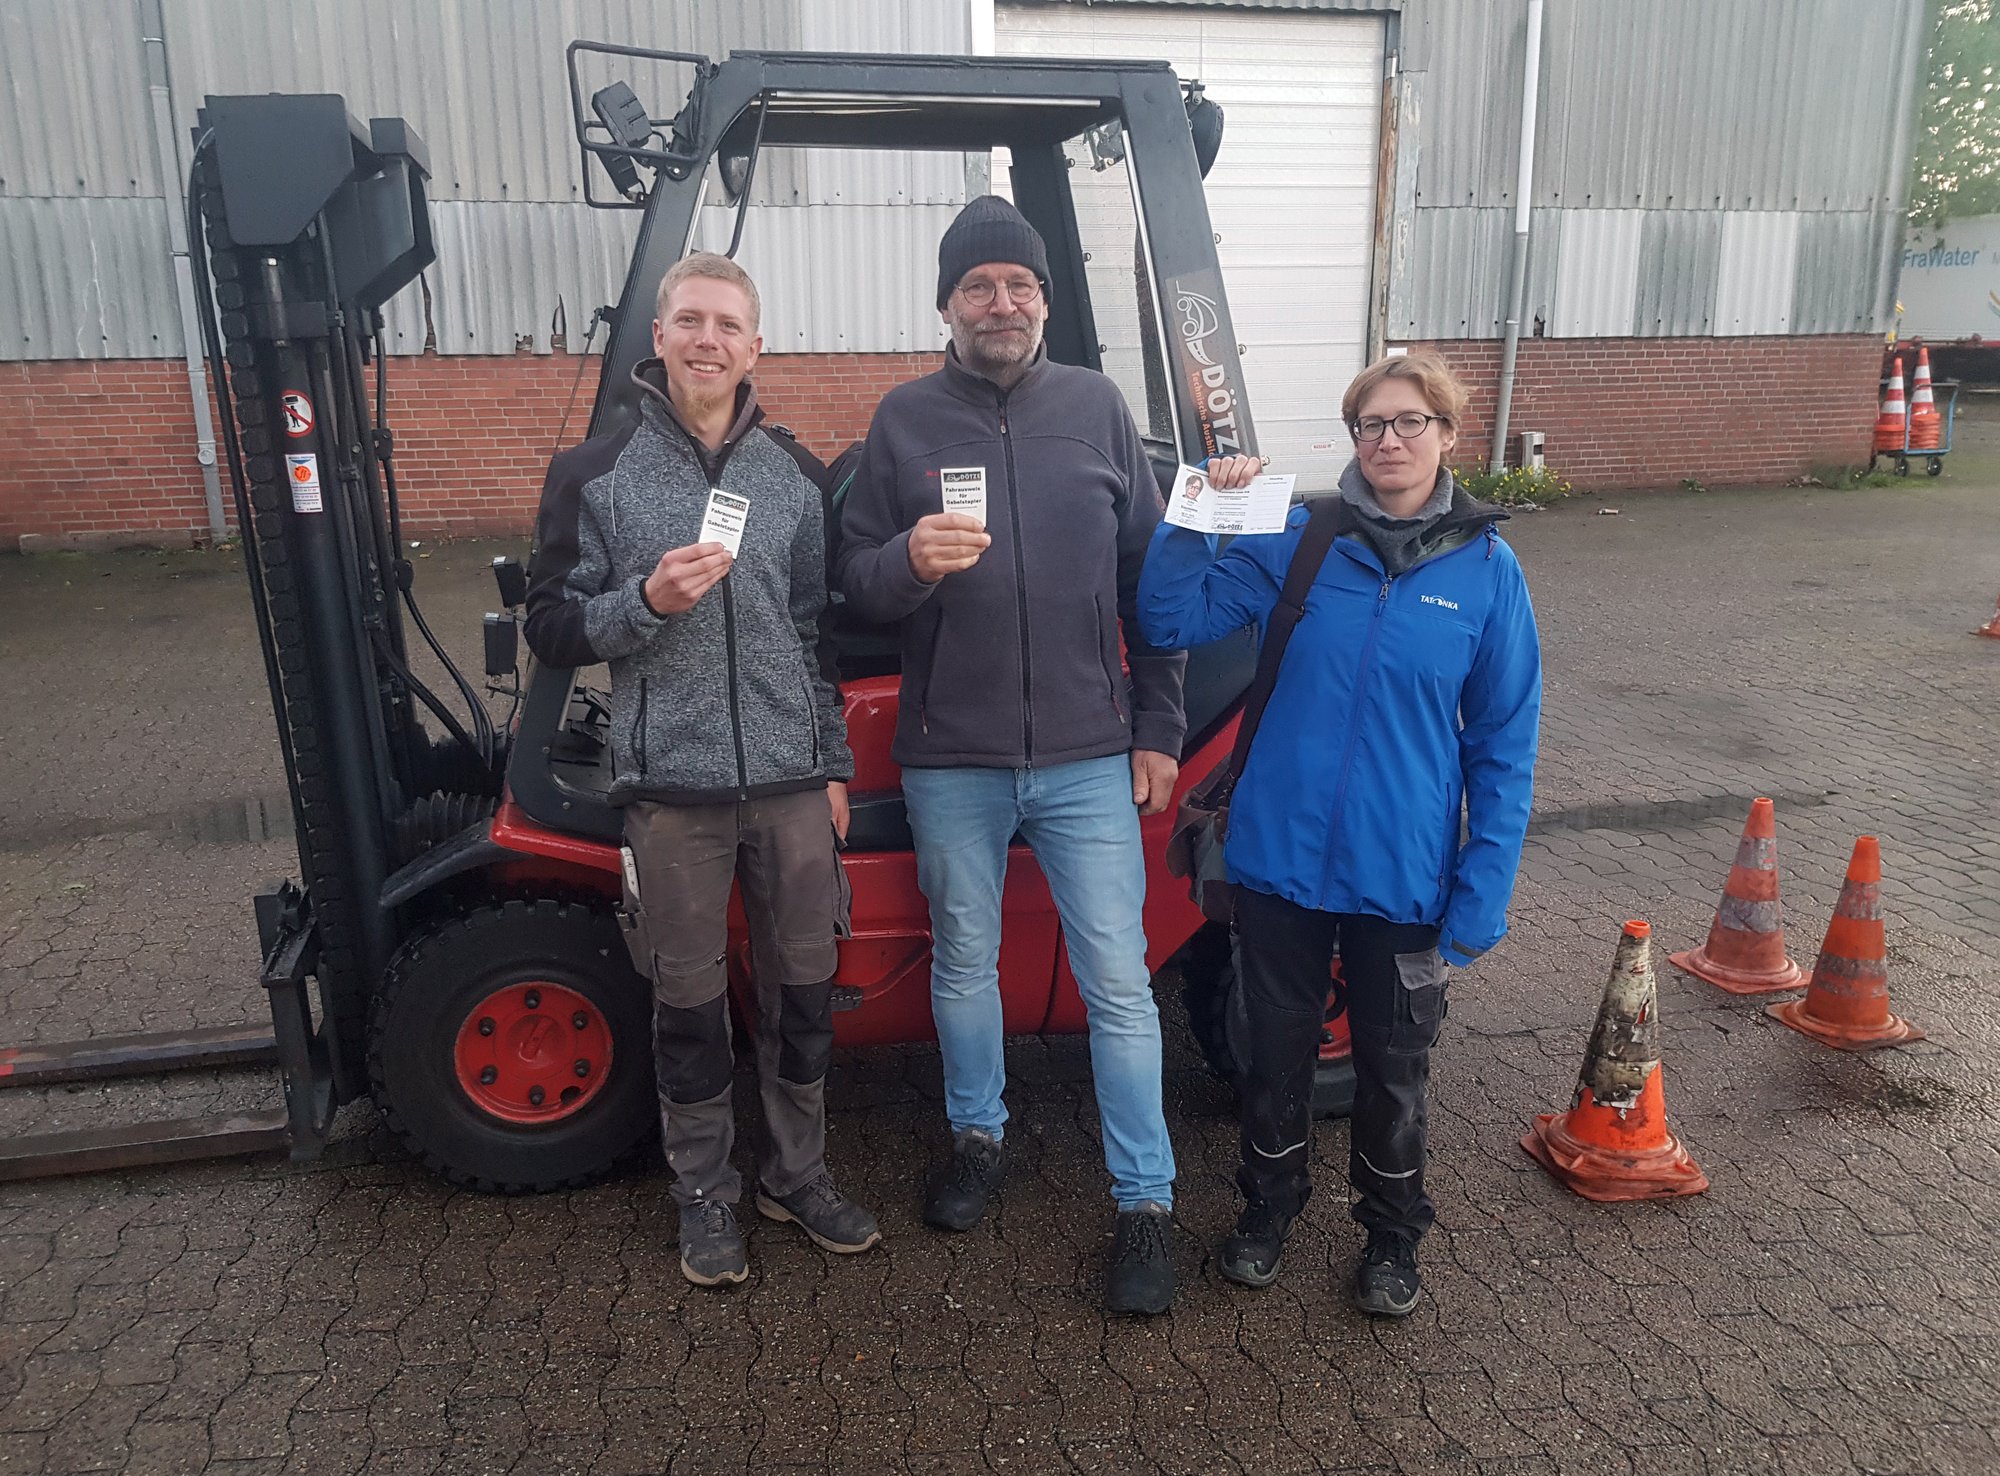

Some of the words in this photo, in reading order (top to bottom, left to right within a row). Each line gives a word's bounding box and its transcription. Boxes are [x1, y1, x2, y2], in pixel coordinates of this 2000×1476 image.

[1902, 247, 1979, 267] FraWater
[1192, 371, 1207, 420] Technische
[711, 508, 742, 521] Fahrausweis
[707, 520, 740, 533] Gabelstapler
[1421, 595, 1458, 610] TATONKA
